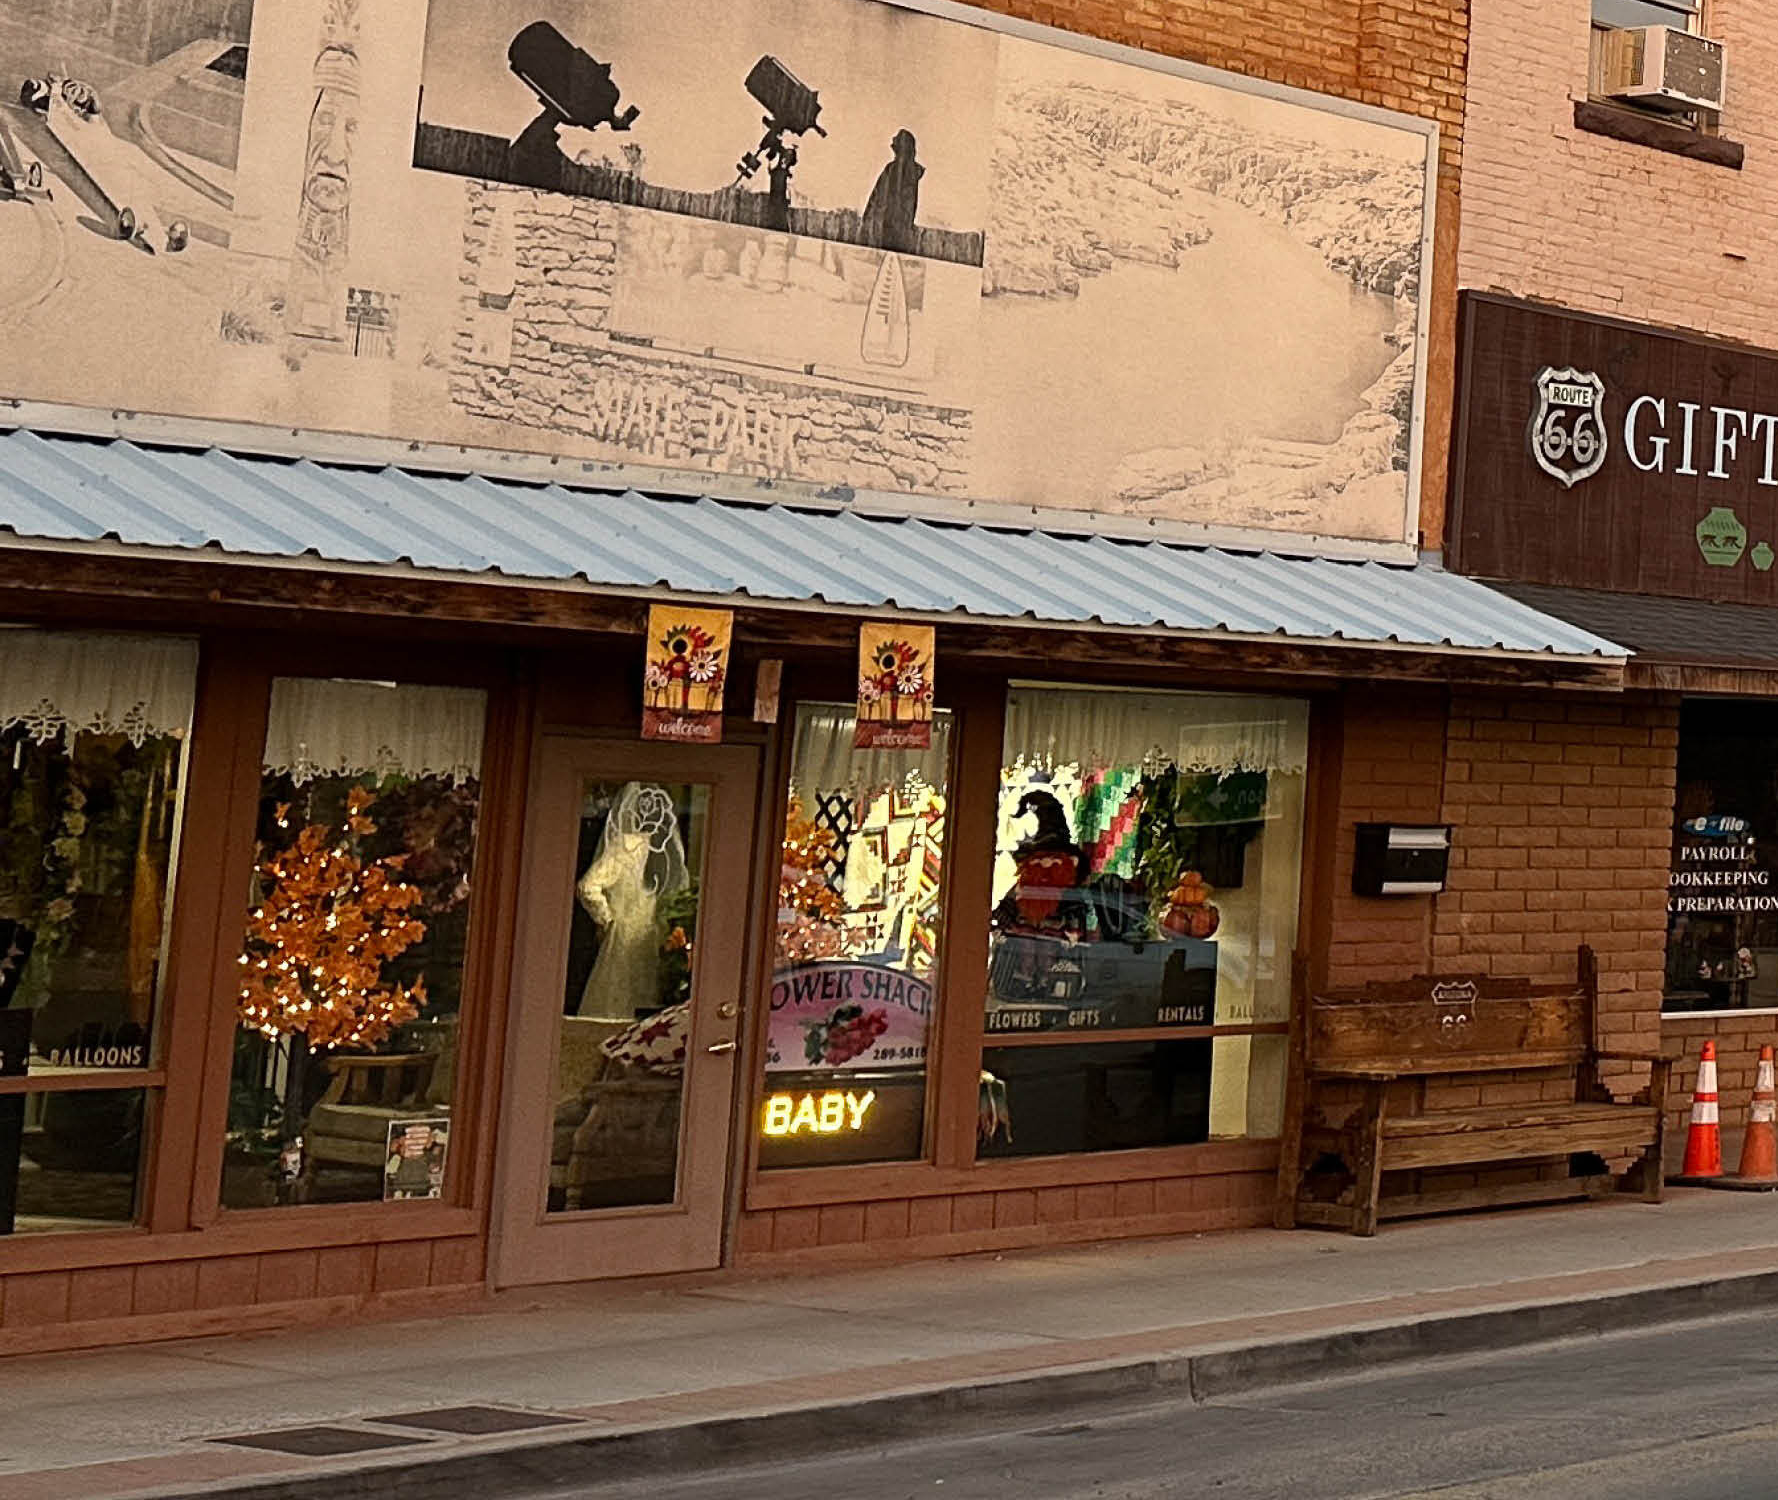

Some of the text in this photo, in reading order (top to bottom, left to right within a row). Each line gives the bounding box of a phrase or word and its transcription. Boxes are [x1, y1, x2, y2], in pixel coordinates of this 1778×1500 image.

[1553, 386, 1590, 405] ROUTE
[1543, 410, 1597, 463] 66
[1681, 846, 1749, 861] PAYROLL
[1670, 871, 1769, 887] OOKKEEPING
[770, 970, 853, 1011] OWER
[990, 1012, 1041, 1028] FLOWERS
[1068, 1009, 1100, 1025] GIFTS
[1158, 1006, 1205, 1022] RENTALS
[51, 1046, 144, 1066] BALLOONS
[764, 1090, 876, 1135] BABY
